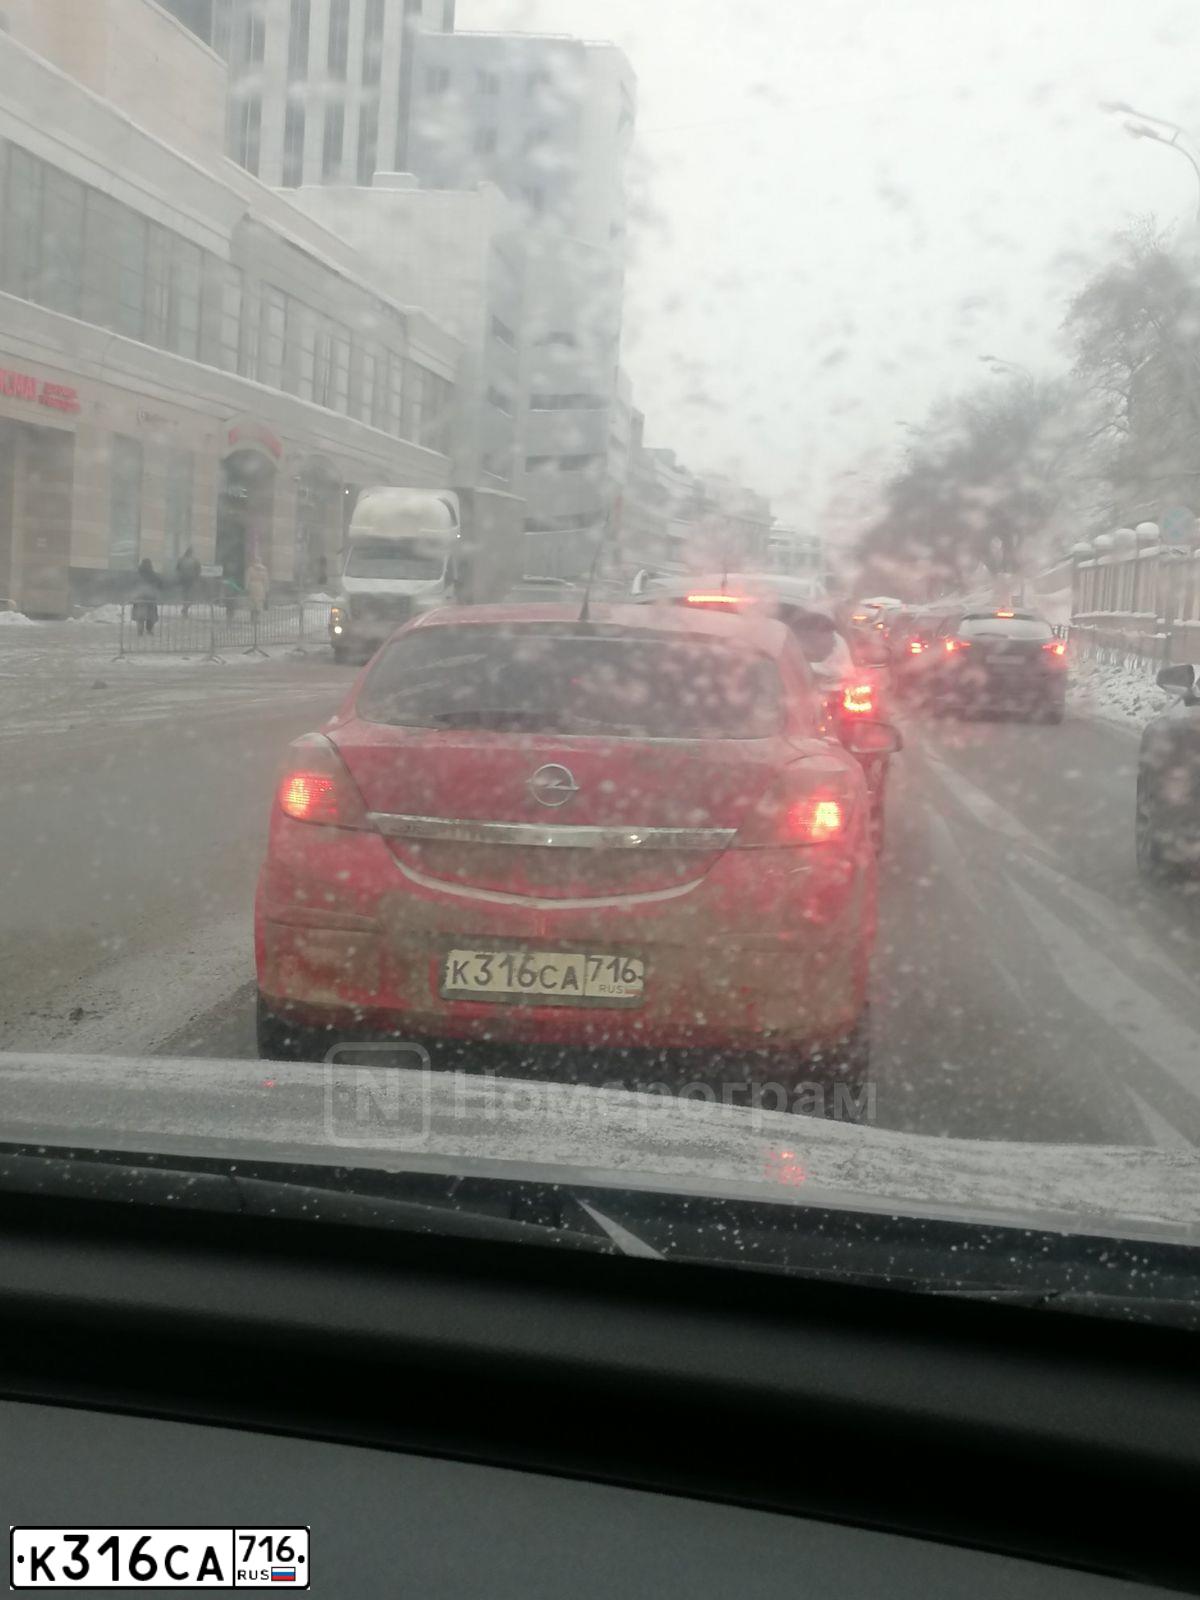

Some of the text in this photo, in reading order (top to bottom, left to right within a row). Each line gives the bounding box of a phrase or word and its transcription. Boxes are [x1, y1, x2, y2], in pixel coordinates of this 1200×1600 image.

[451, 954, 637, 991] К316СА 716
[599, 984, 625, 994] RUS
